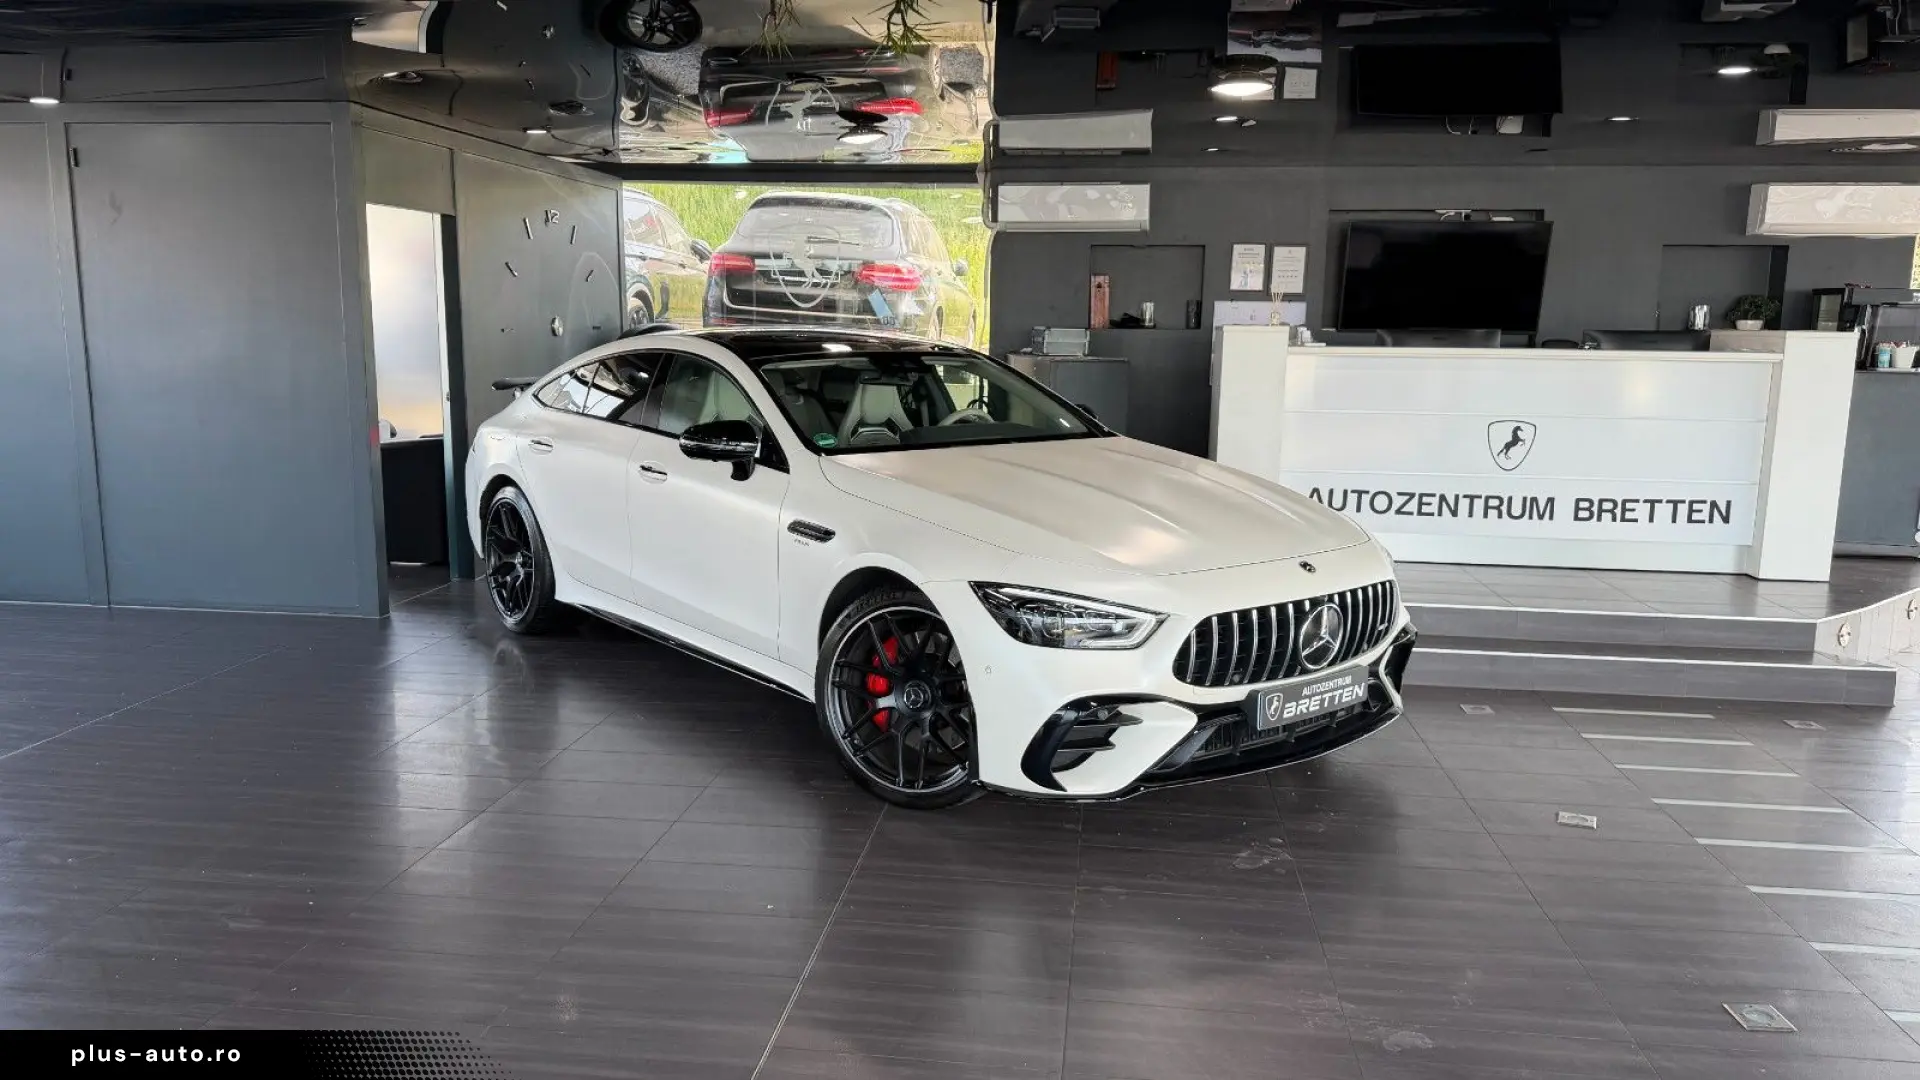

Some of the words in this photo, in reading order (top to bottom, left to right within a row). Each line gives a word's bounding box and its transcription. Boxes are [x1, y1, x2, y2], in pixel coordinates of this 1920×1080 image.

[545, 209, 560, 225] 12
[1573, 497, 1732, 524] BRETTEN
[1301, 675, 1352, 696] AUTOZENTRUM
[1283, 683, 1365, 718] BRETTEN
